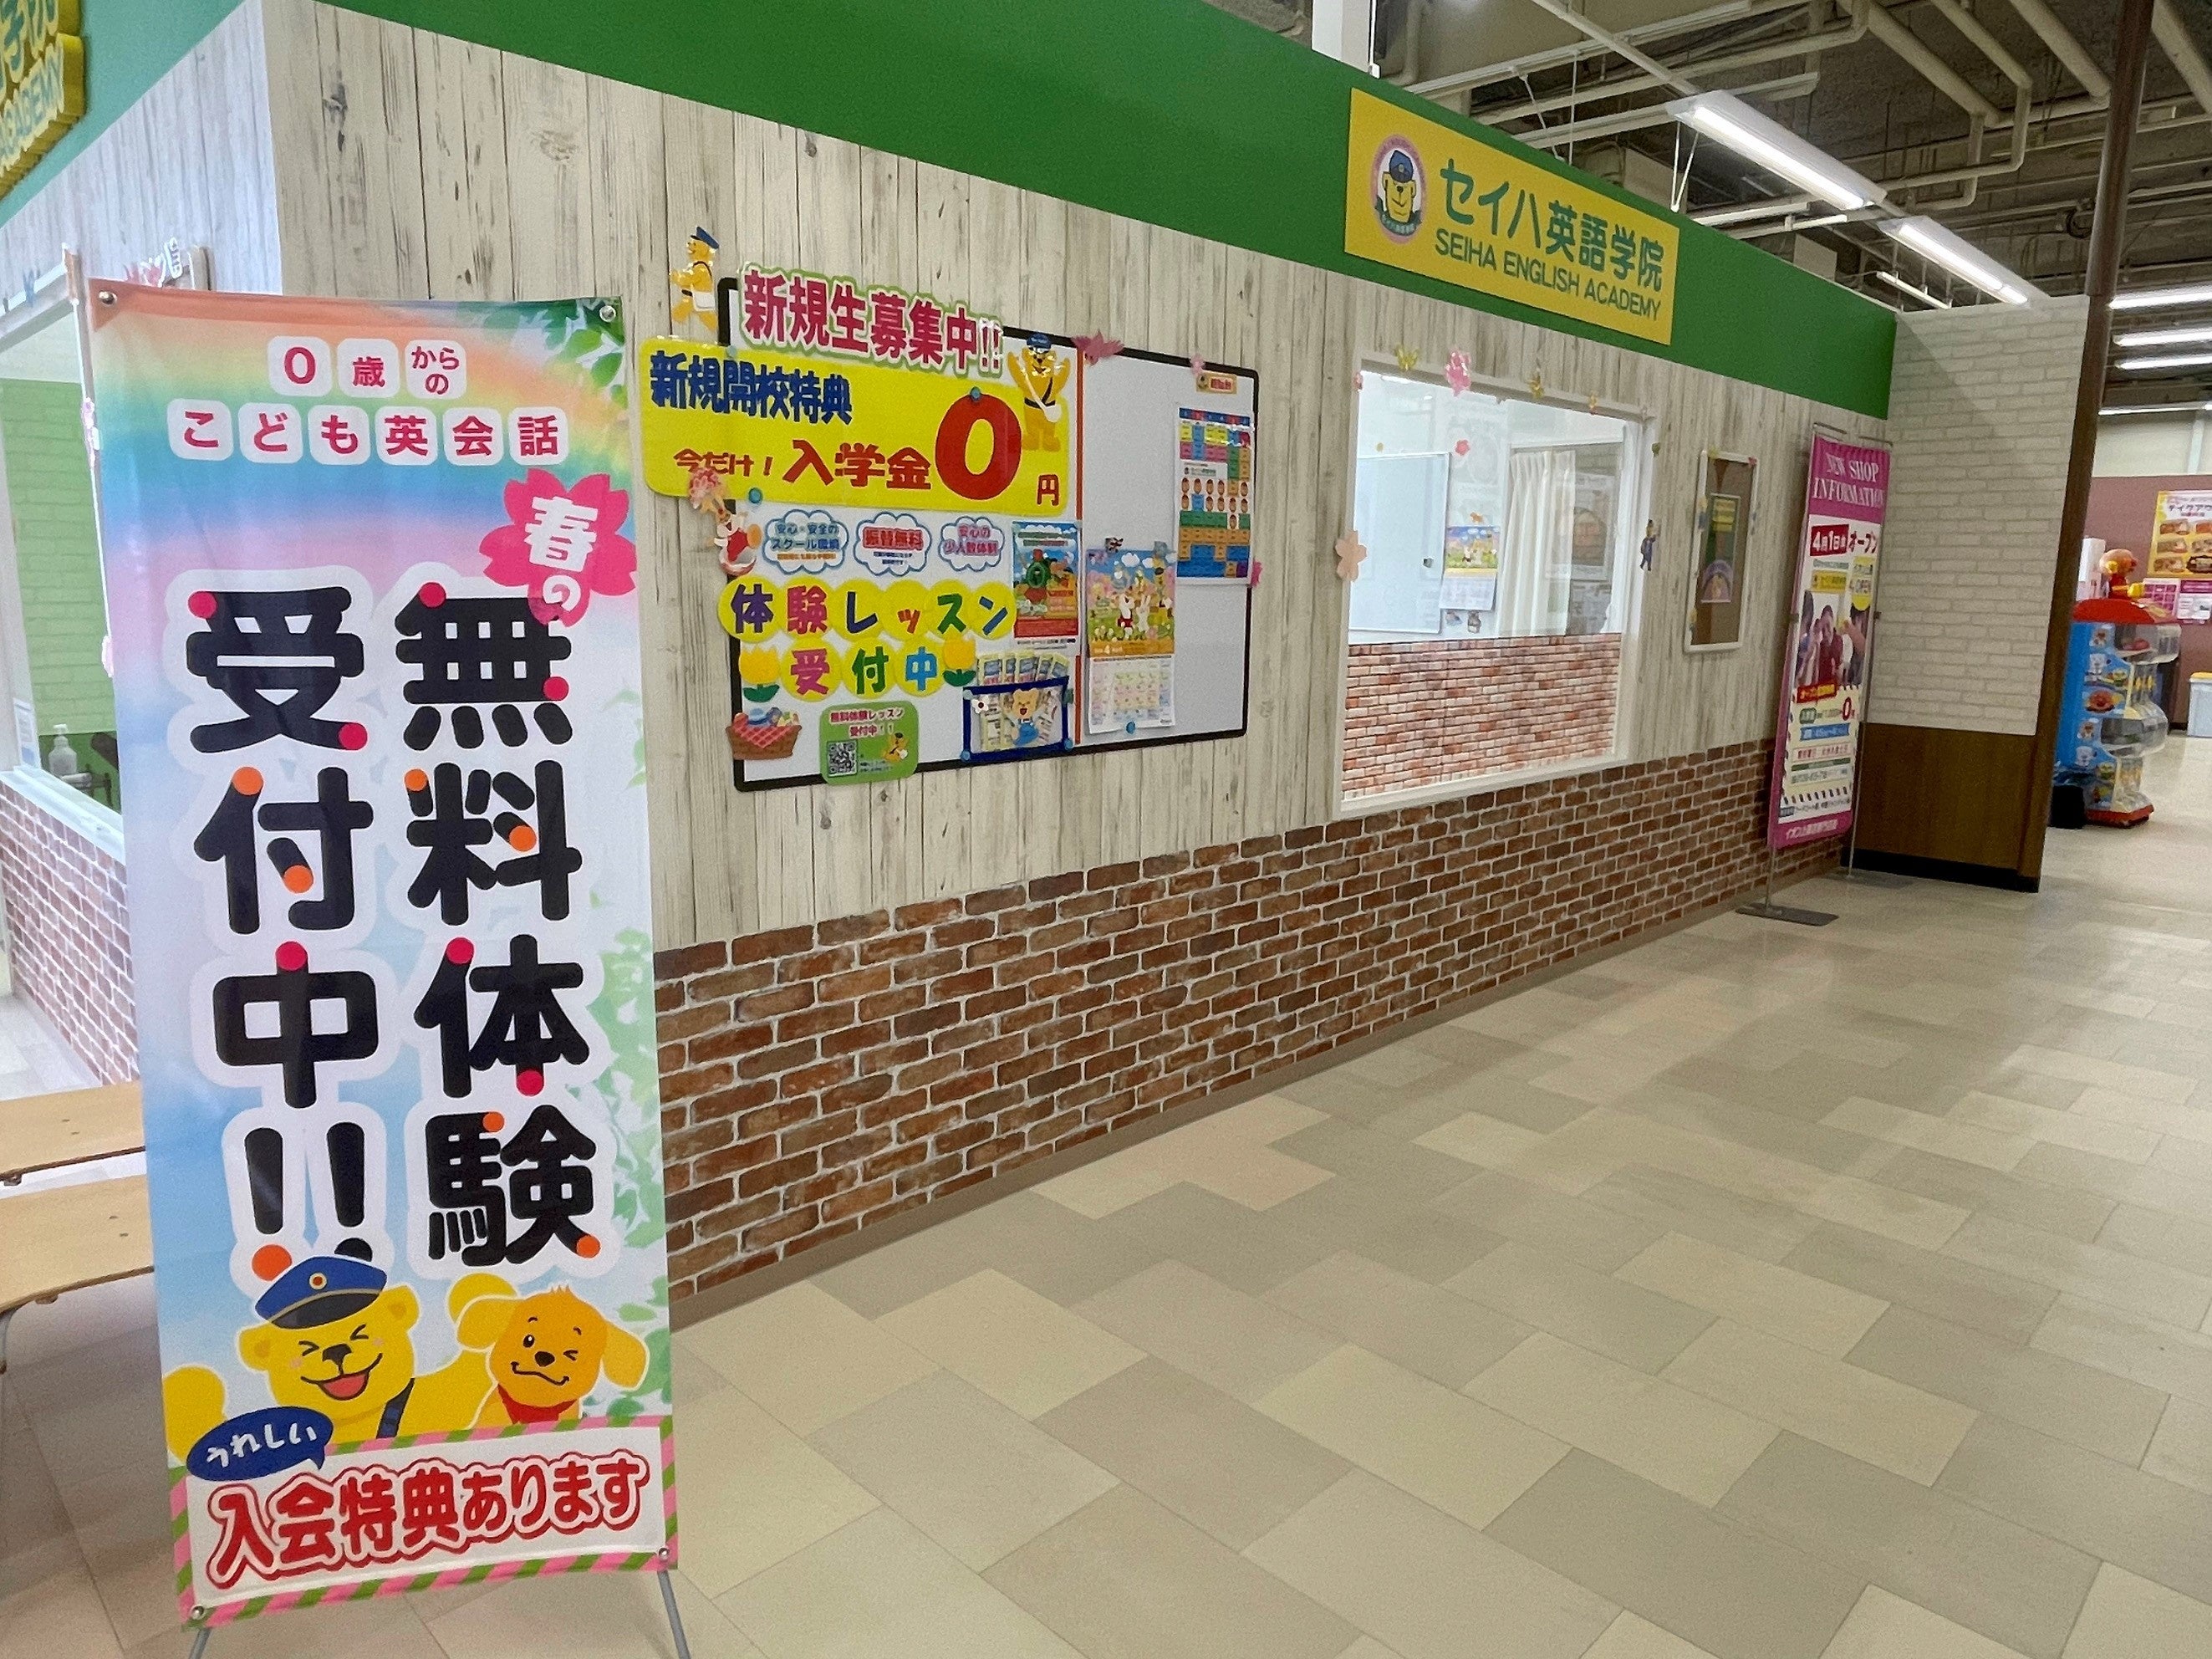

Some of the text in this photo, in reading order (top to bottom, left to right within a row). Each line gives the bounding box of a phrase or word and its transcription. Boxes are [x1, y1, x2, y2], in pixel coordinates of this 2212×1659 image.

[1440, 158, 1664, 292] セイハ英語学院
[1435, 227, 1662, 321] SEIHA ENGLISH ACADEMY
[743, 269, 1001, 370] 新規生募集中!!
[650, 350, 852, 425] 新規開校特典
[181, 410, 560, 457] こども英会話
[1848, 460, 1879, 482] SHOP
[730, 583, 1008, 635] 体験レッスン
[789, 646, 938, 696] 受付中
[394, 581, 602, 1266] 無料体験
[206, 1422, 315, 1468] うれしい
[212, 1455, 645, 1582] 入会特典あります
